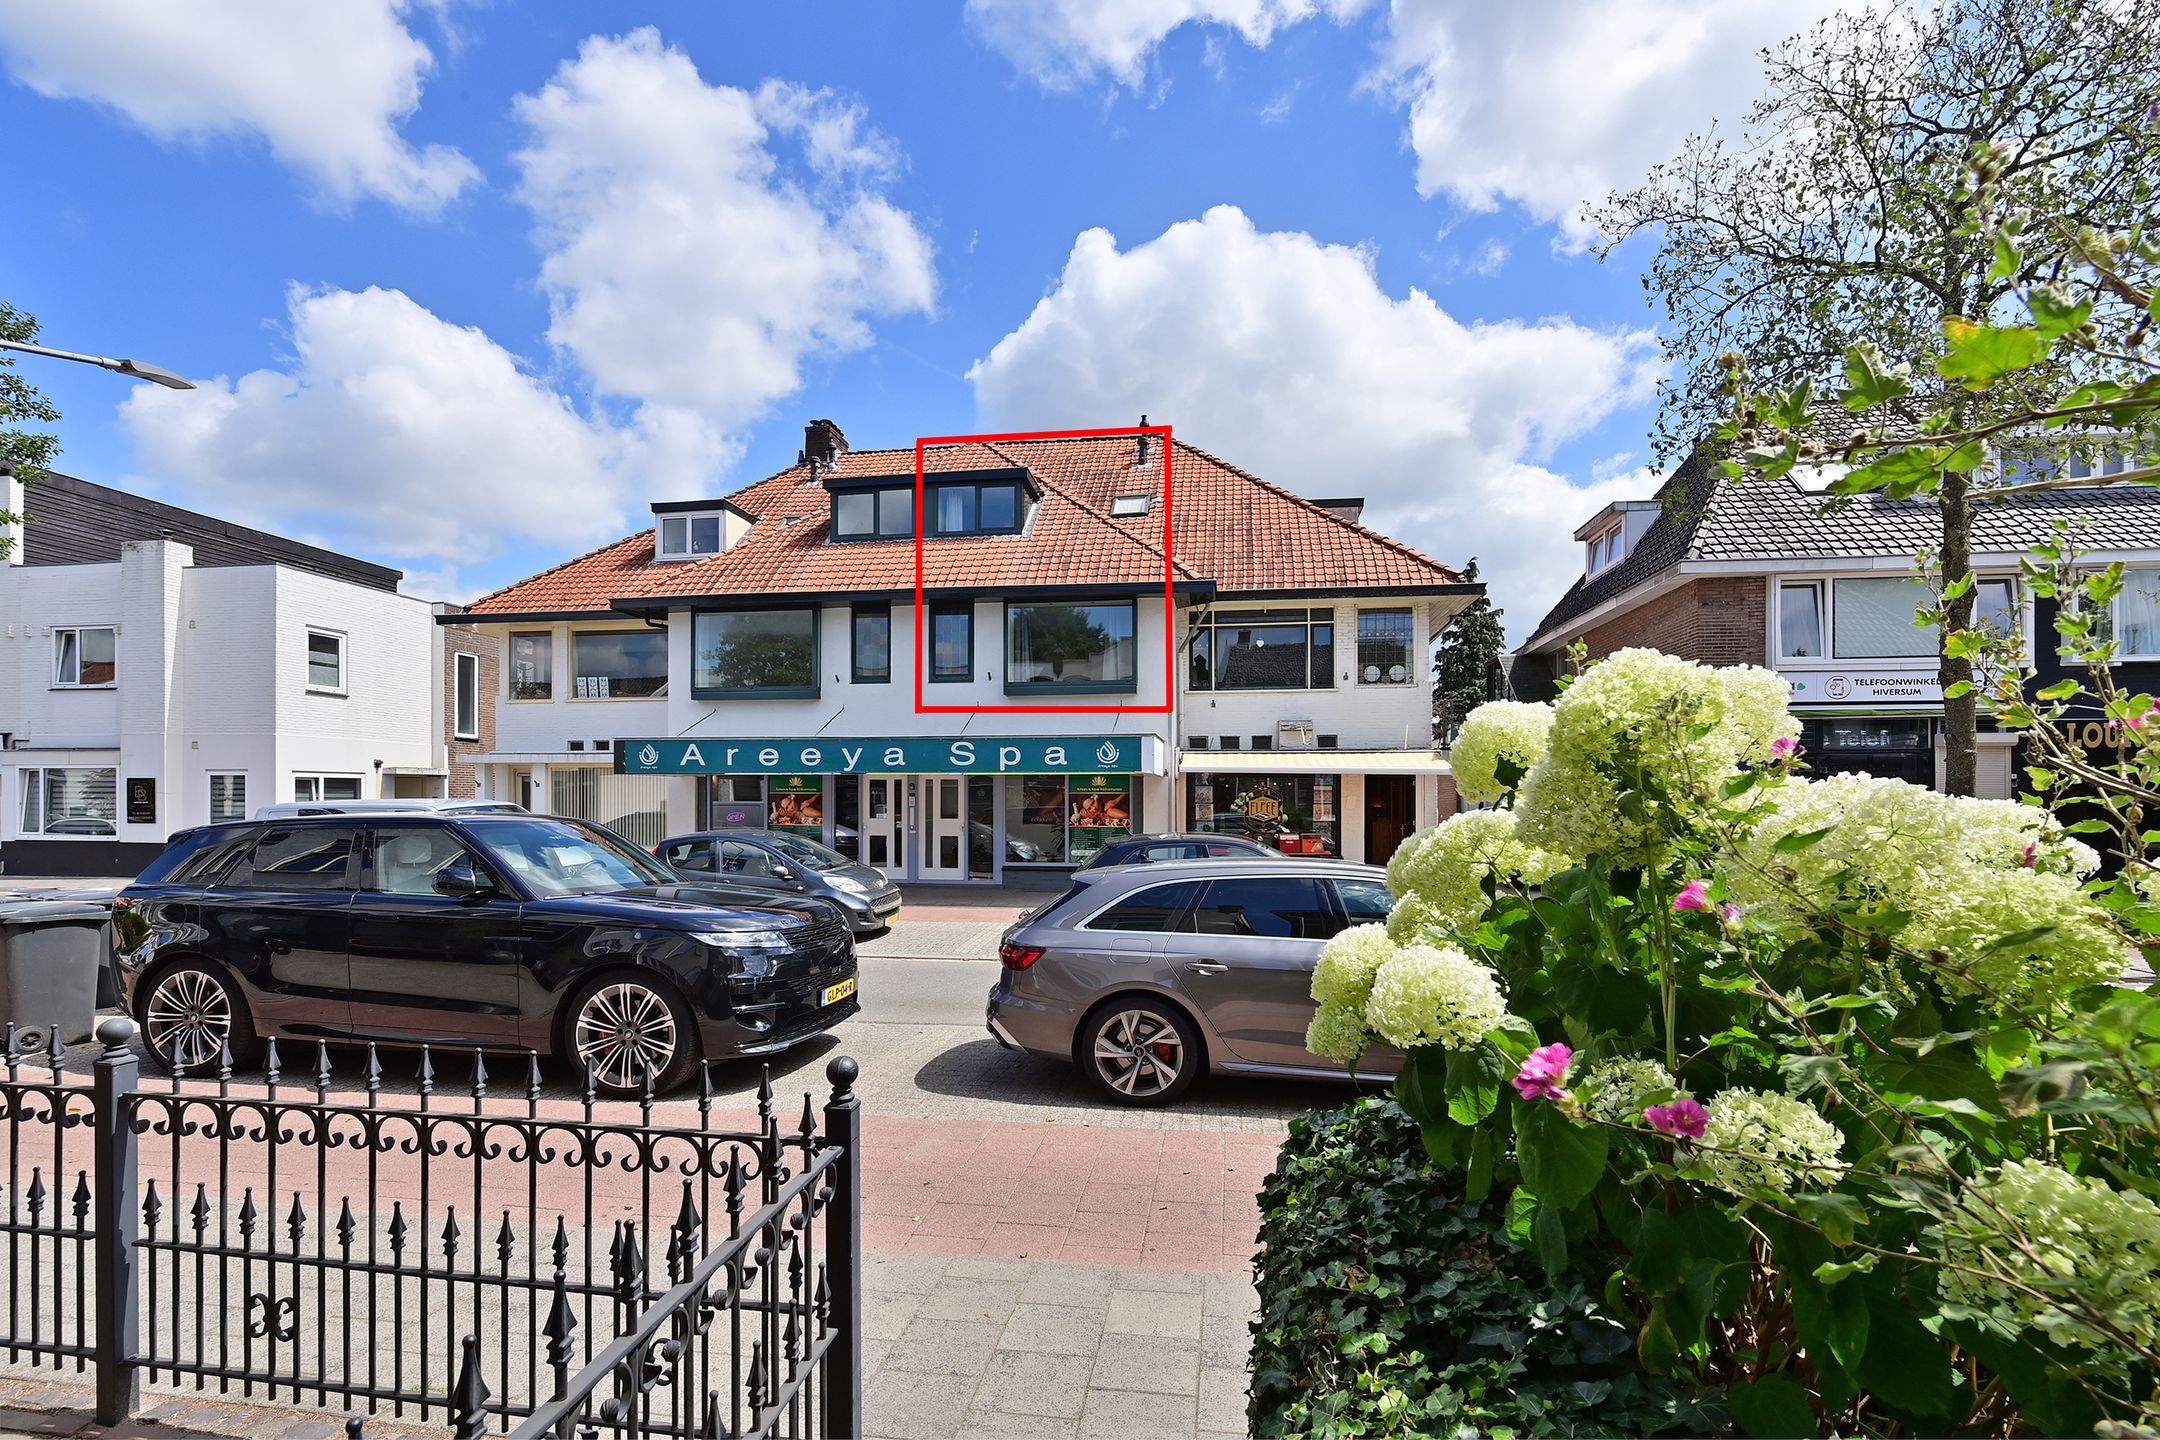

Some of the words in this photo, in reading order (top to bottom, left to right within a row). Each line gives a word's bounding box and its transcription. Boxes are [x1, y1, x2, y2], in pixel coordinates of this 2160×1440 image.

[1872, 688, 1922, 696] HIVERSUM
[679, 743, 906, 772] Areeya
[949, 741, 1068, 772] Spa
